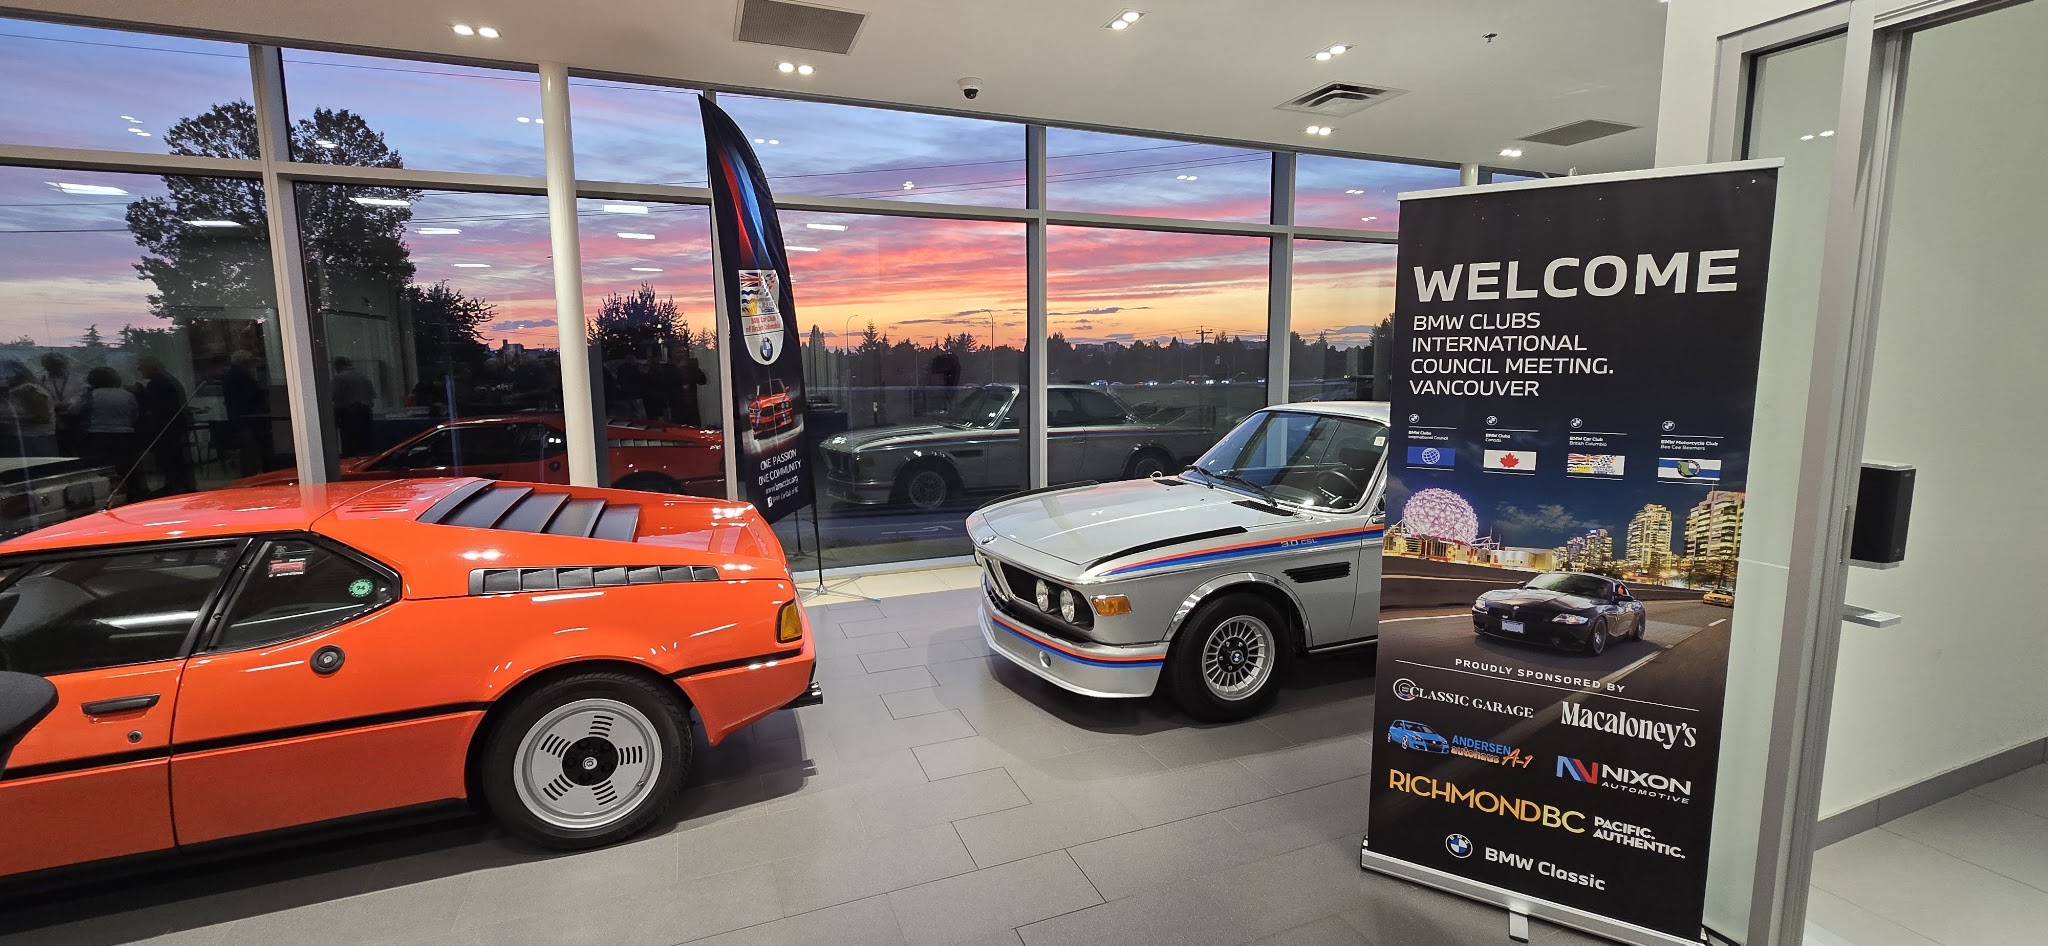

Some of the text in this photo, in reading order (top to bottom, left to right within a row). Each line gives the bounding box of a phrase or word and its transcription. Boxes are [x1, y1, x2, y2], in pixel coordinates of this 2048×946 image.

[1413, 249, 1740, 302] WELCOME
[1413, 312, 1541, 331] BMW CLUBS
[1412, 335, 1588, 353] INTERNATIONAL
[1411, 357, 1614, 374] COUNCIL MEETING.
[1409, 380, 1540, 397] VANCOUVER
[760, 448, 796, 470] ONE PASSION
[758, 460, 801, 486] ONE COMMUNITY
[1281, 539, 1299, 548] 3.0
[1455, 658, 1625, 693] PROUDLY SPONSORED BY
[1410, 686, 1534, 718] CLASSIC GARAGE
[1561, 701, 1697, 750] Macaloney's
[1452, 734, 1512, 756] ANDERSEN
[1450, 746, 1534, 768] autohaus A-1
[1601, 763, 1692, 796] NIXON
[1602, 782, 1690, 804] AUTOMOTIVE
[1594, 816, 1656, 840] PACIFIC.
[1592, 829, 1686, 859] AUTHENTIC.
[1485, 847, 1606, 891] BMW Classic
